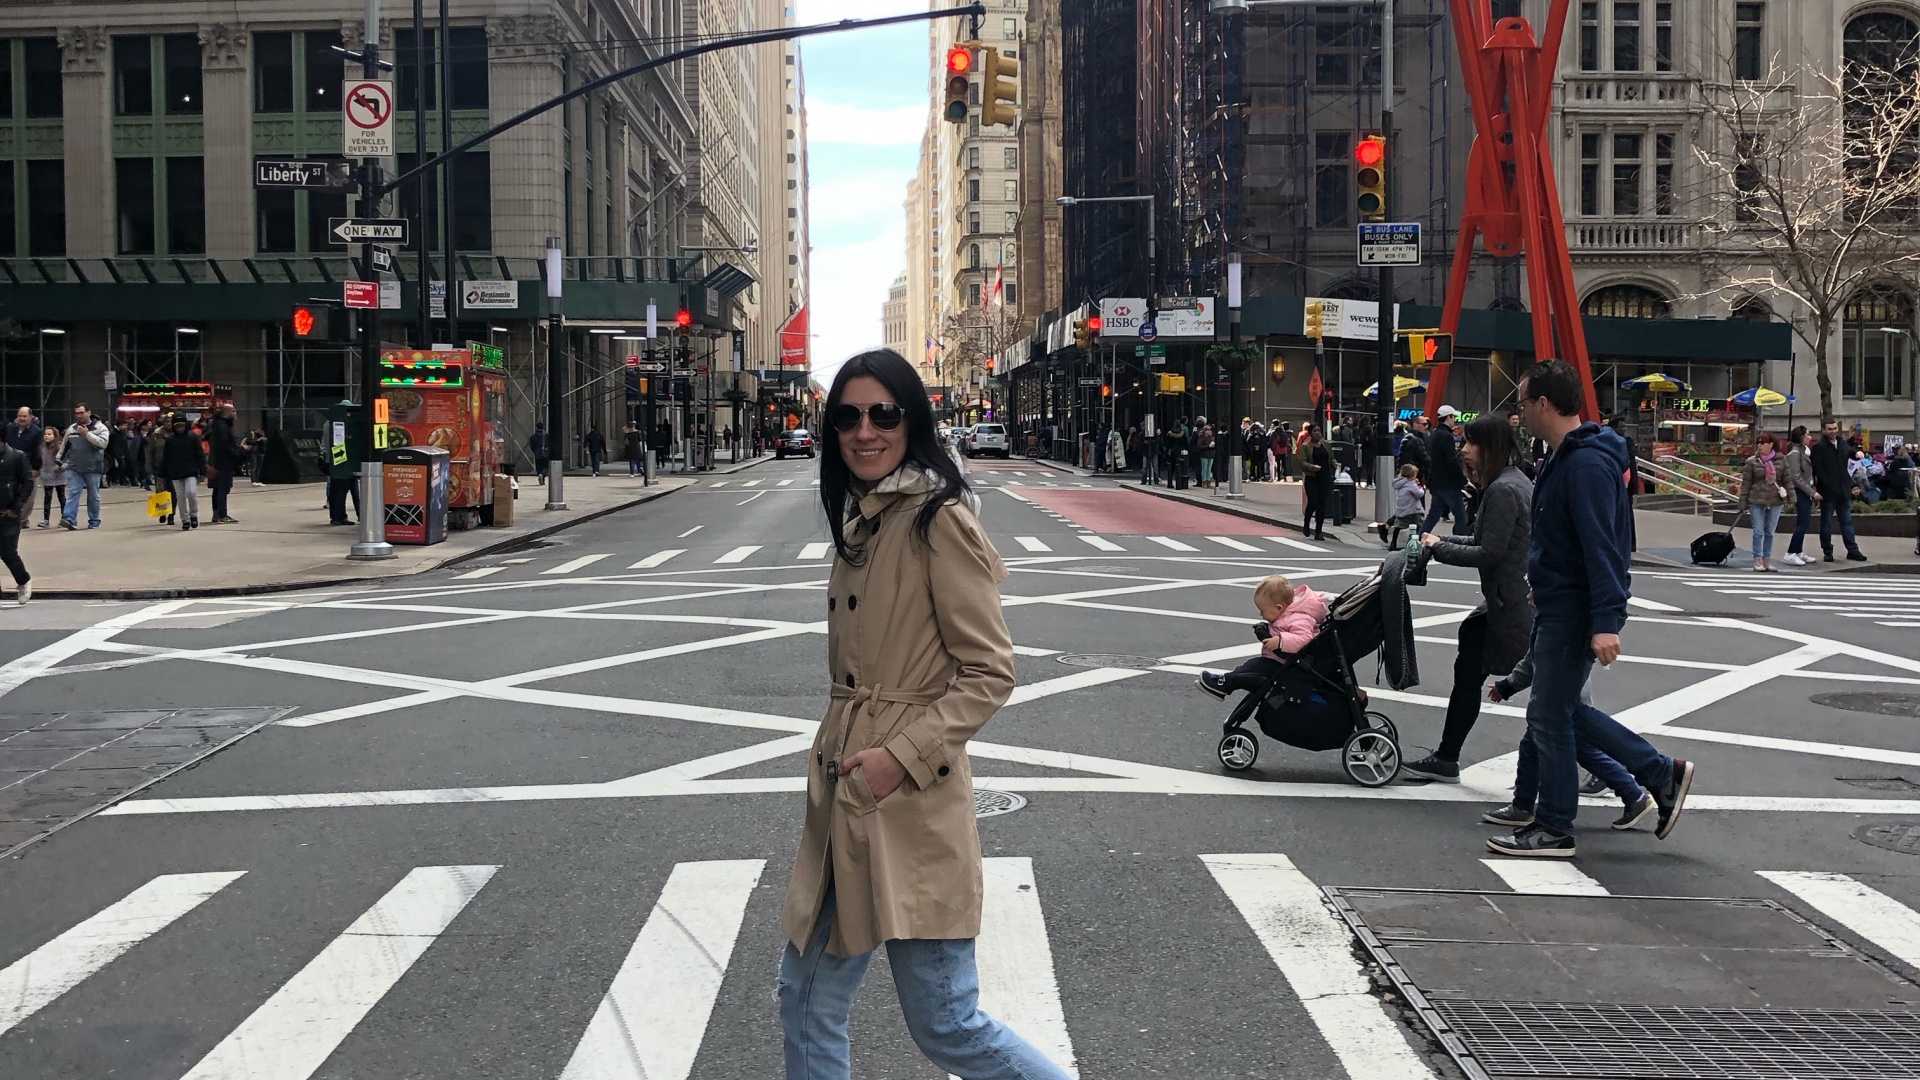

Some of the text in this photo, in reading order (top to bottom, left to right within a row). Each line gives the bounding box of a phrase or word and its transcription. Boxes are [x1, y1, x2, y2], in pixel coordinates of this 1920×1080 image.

[260, 166, 321, 185] Liberty ST
[343, 226, 397, 237] ONE WAY
[1171, 299, 1190, 307] Cedar
[1322, 304, 1339, 313] REST
[1106, 318, 1139, 328] HSBC
[1349, 315, 1379, 324] wewo
[1673, 399, 1709, 412] PPLE
[1455, 412, 1479, 422] AGE
